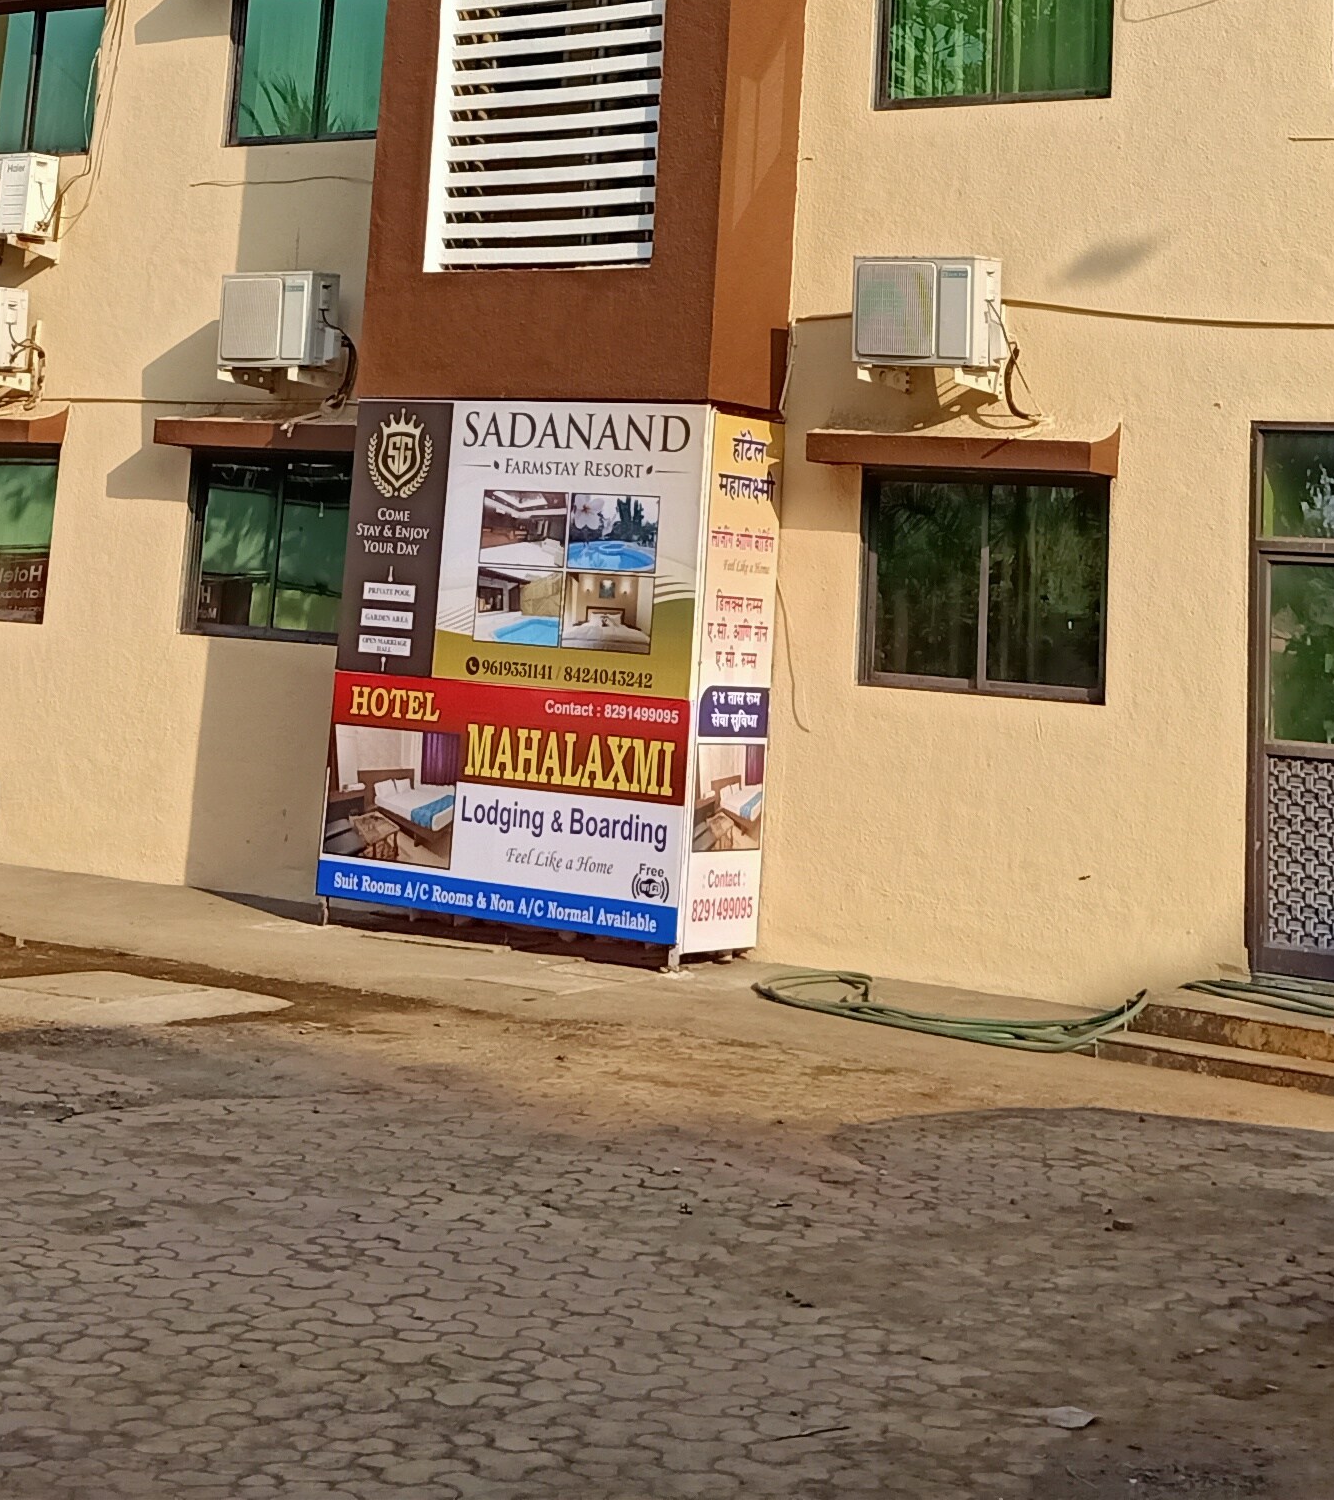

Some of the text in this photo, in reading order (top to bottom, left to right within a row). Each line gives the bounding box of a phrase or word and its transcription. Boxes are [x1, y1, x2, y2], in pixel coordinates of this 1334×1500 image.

[463, 411, 690, 453] SADANAND
[733, 430, 767, 463] हॉटेल
[383, 525, 393, 538] &
[482, 661, 553, 681] 9619331141
[563, 666, 653, 689] 8424043242
[349, 686, 440, 722] HOTEL
[545, 700, 594, 717] Contact
[604, 703, 679, 725] 8291499095
[464, 724, 676, 797] MAHALAXMI
[461, 795, 667, 852] Lodging & Boarding
[506, 848, 614, 875] Feel Like a Home
[639, 863, 664, 878] Free
[707, 869, 741, 889] Contact
[333, 872, 657, 933] Suit Rooms A/C Rooms & Non A/C Normal Available
[691, 896, 753, 923] 8291499095
